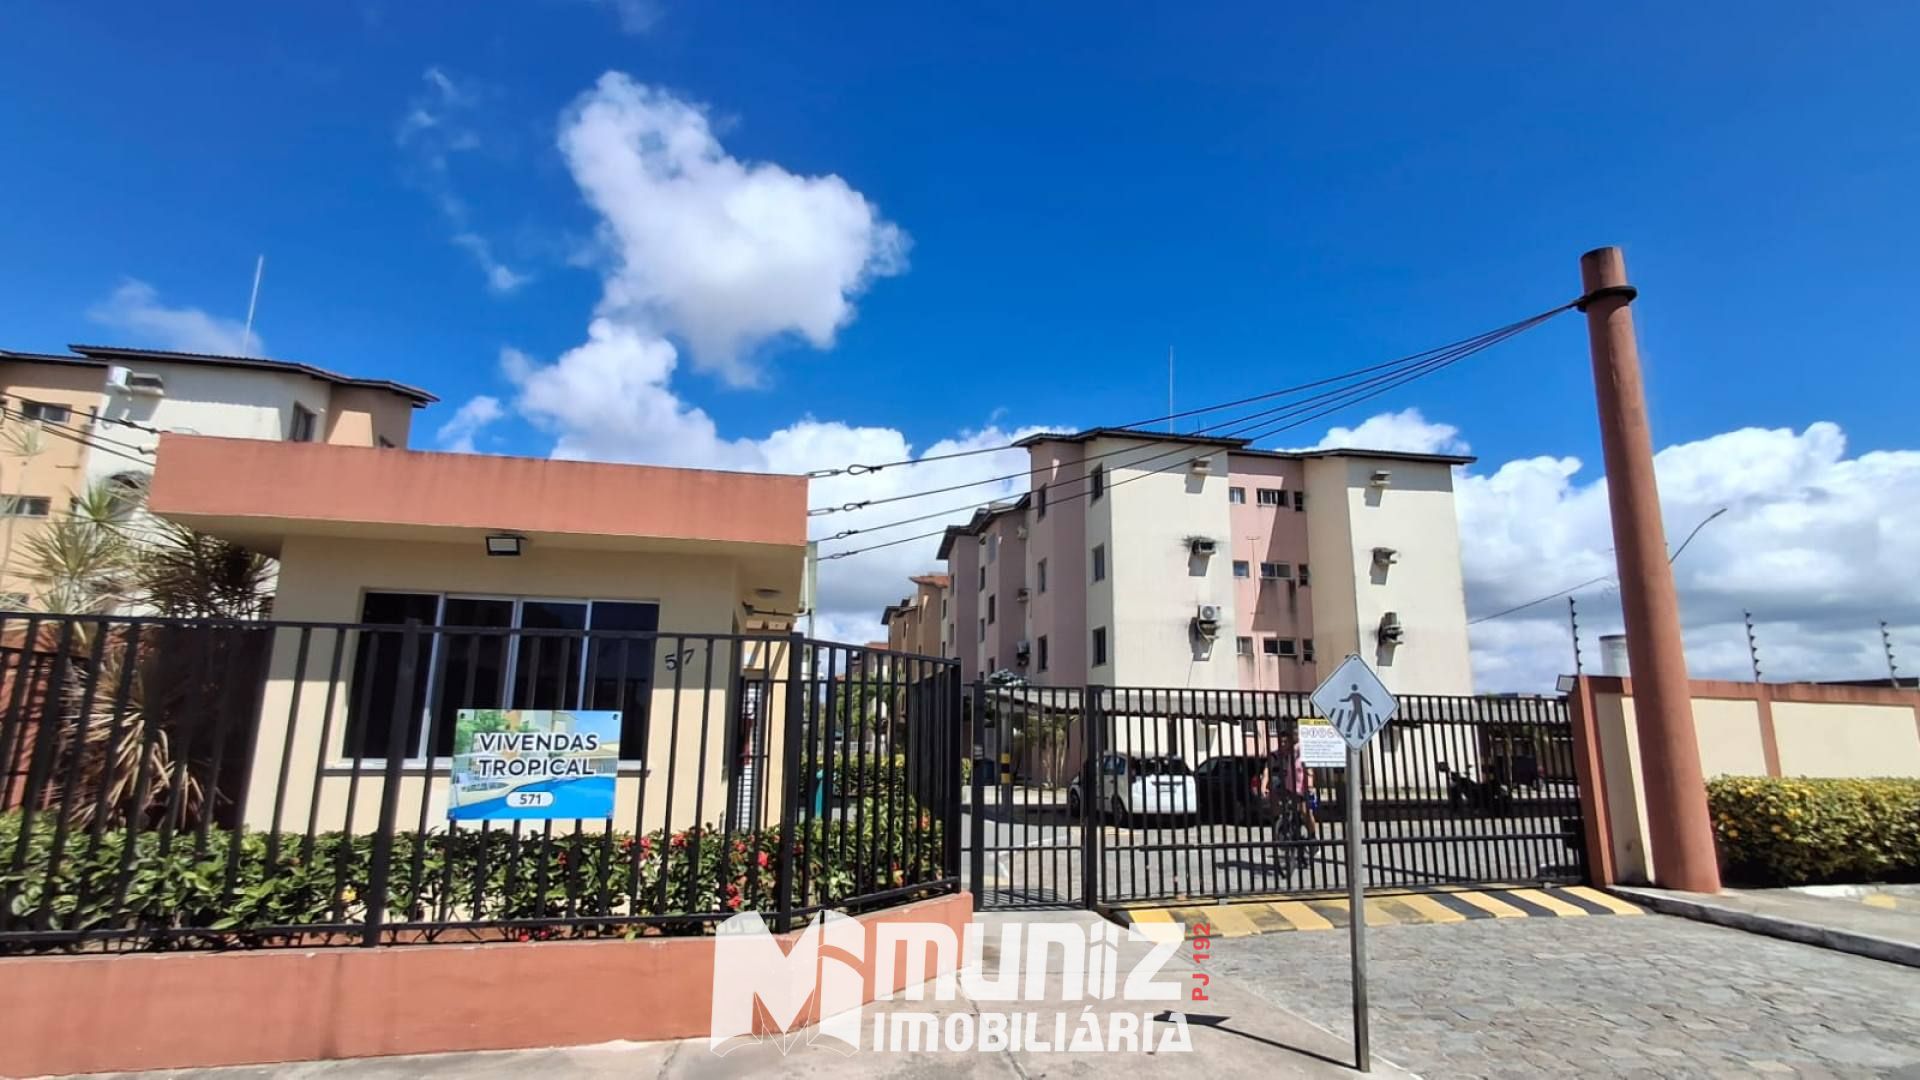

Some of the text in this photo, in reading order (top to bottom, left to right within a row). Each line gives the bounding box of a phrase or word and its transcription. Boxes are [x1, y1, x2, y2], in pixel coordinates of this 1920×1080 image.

[479, 733, 598, 751] VIVENDAS
[478, 758, 595, 776] TROPICAL
[519, 793, 542, 805] 571
